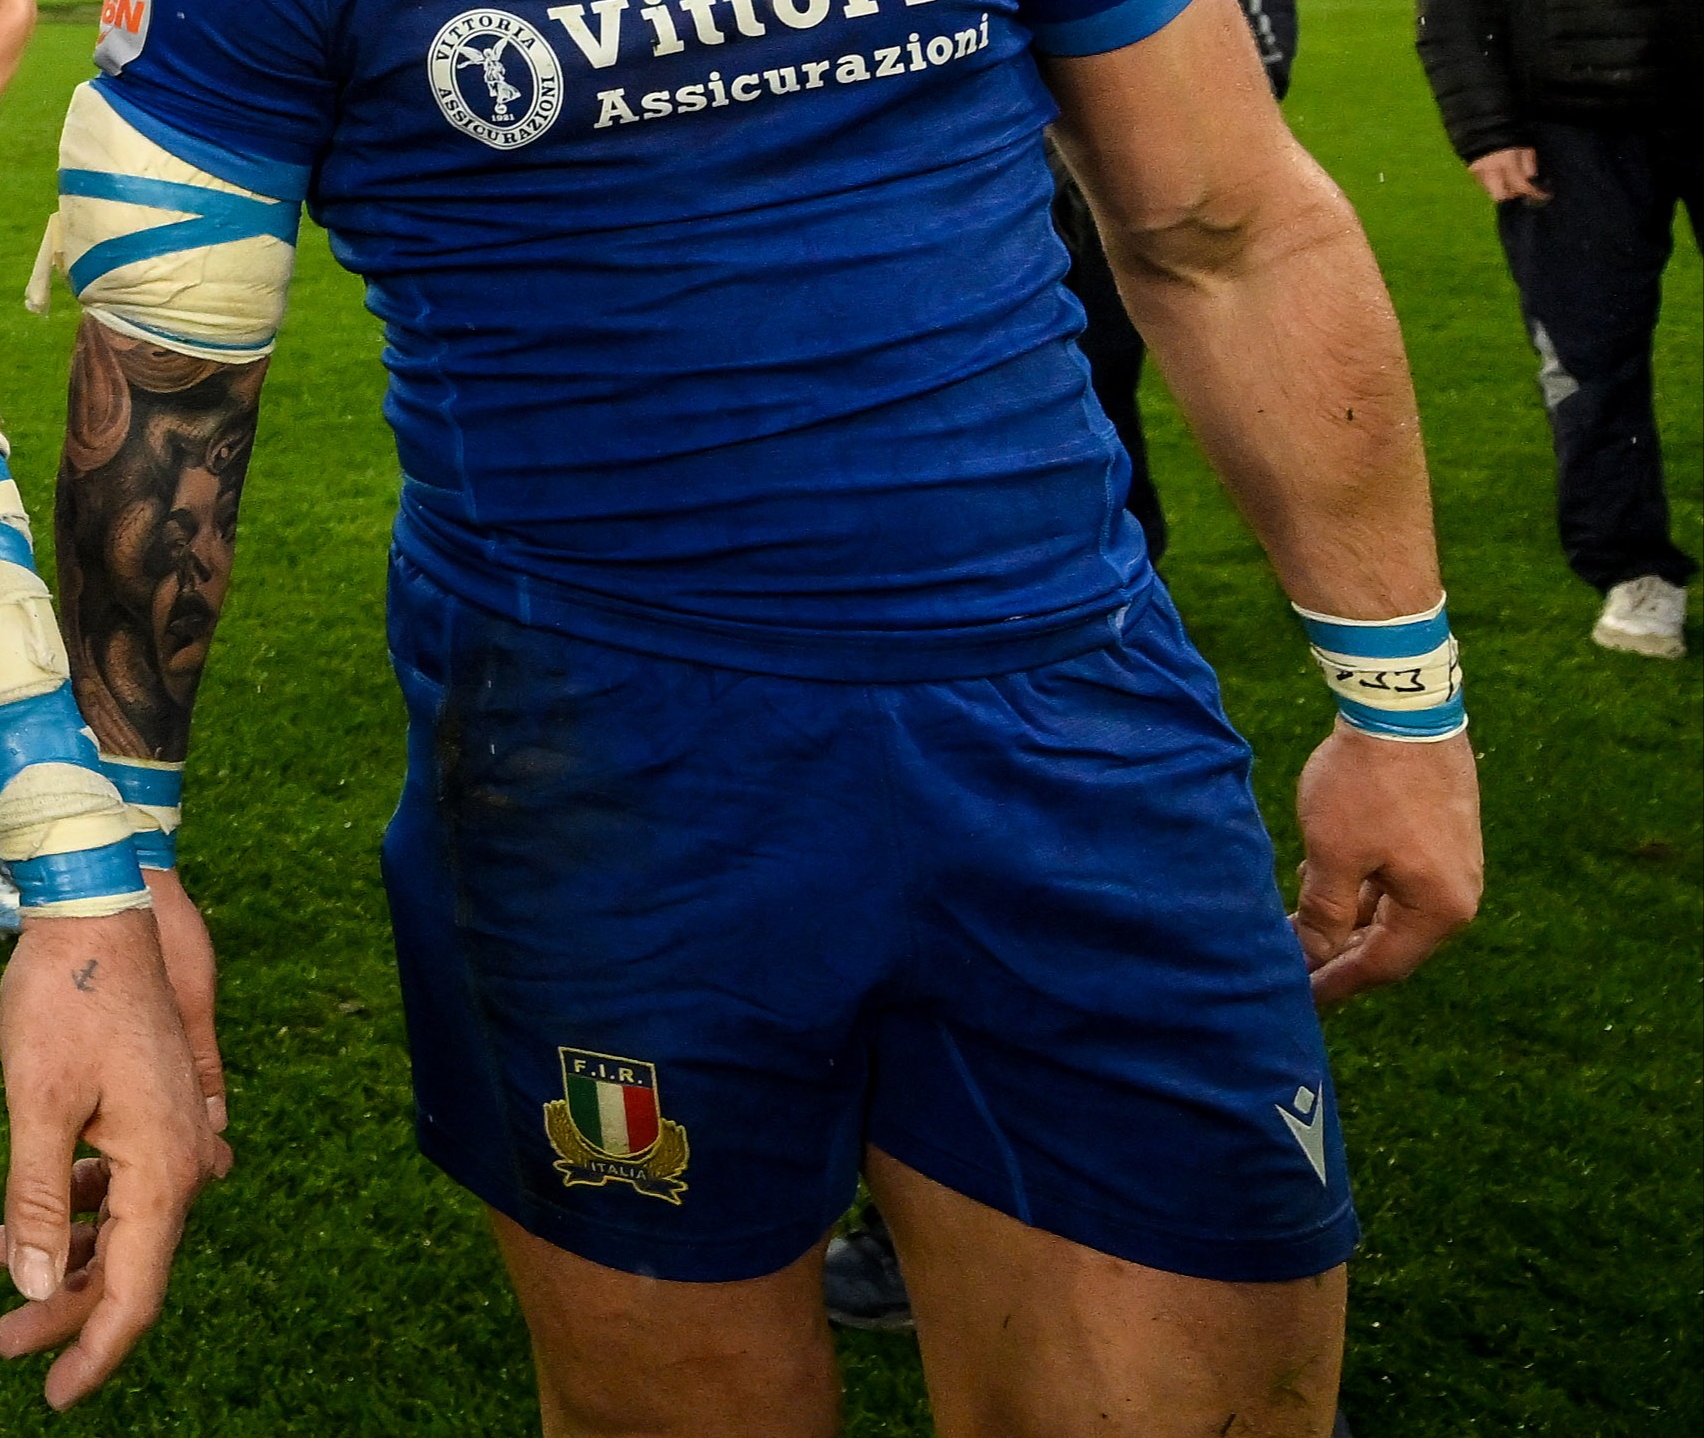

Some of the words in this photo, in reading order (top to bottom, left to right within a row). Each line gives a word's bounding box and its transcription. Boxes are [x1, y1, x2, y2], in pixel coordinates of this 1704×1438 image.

[436, 15, 536, 61] VITTORIA
[594, 13, 989, 129] Assicurazioni
[439, 75, 555, 144] ASSICURAZIONI
[491, 113, 515, 122] 1921
[574, 1059, 643, 1085] F.I.R.
[591, 1162, 647, 1180] ITALIA
